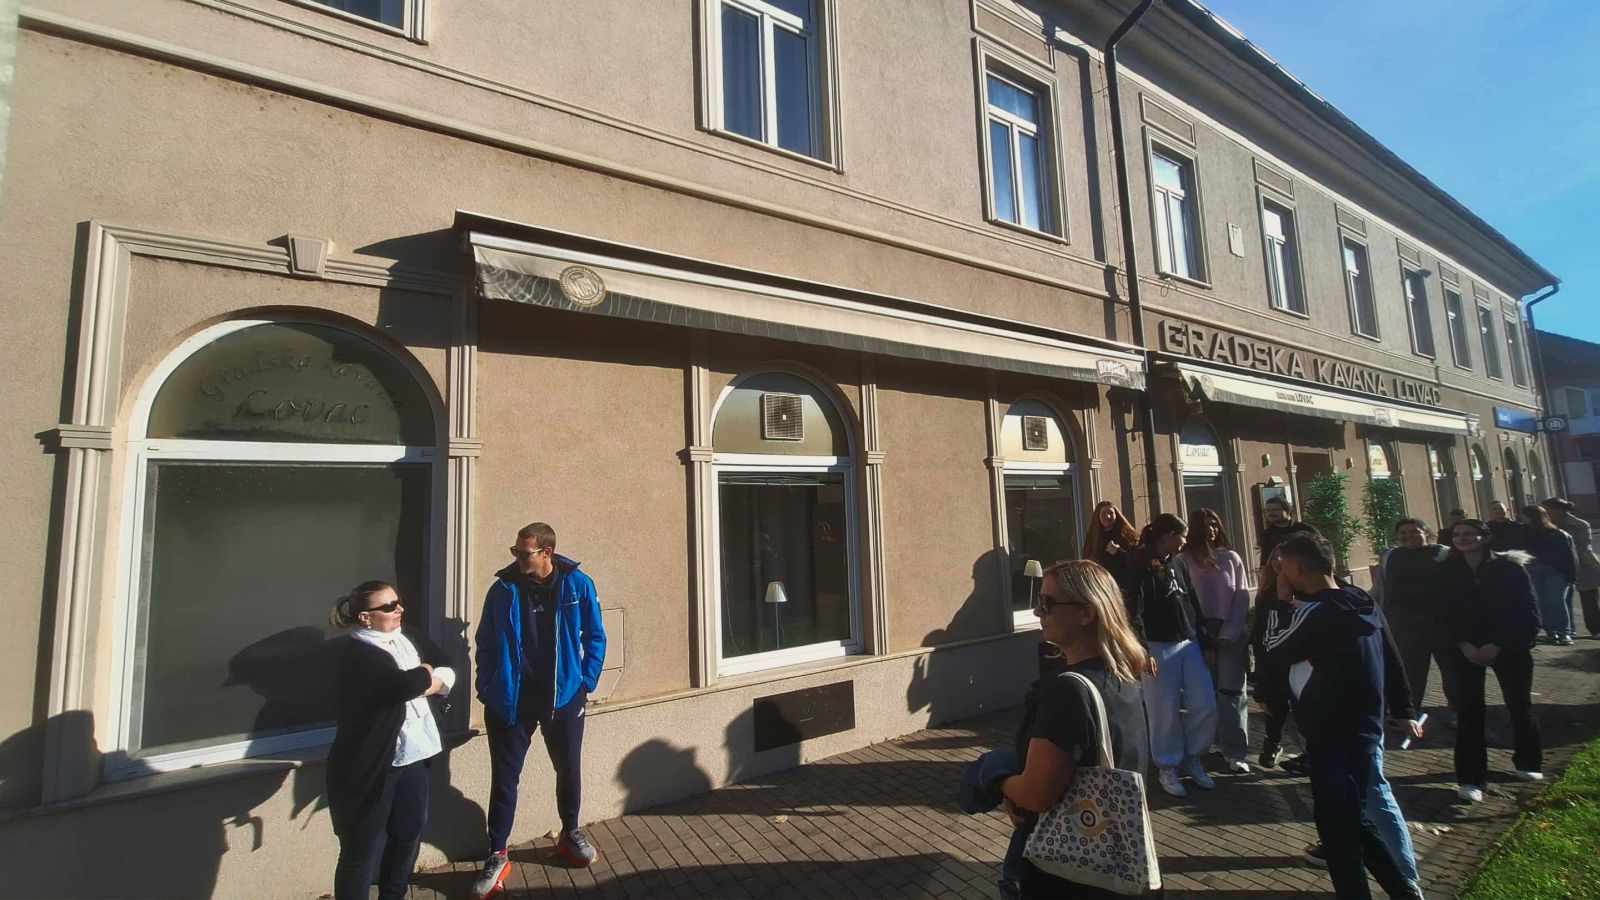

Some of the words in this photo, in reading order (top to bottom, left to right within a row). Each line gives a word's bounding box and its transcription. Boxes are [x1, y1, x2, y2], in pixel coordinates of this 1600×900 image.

[1159, 319, 1306, 379] GRADSKA
[1314, 358, 1389, 395] KAVANA
[1394, 377, 1440, 406] LOVAC
